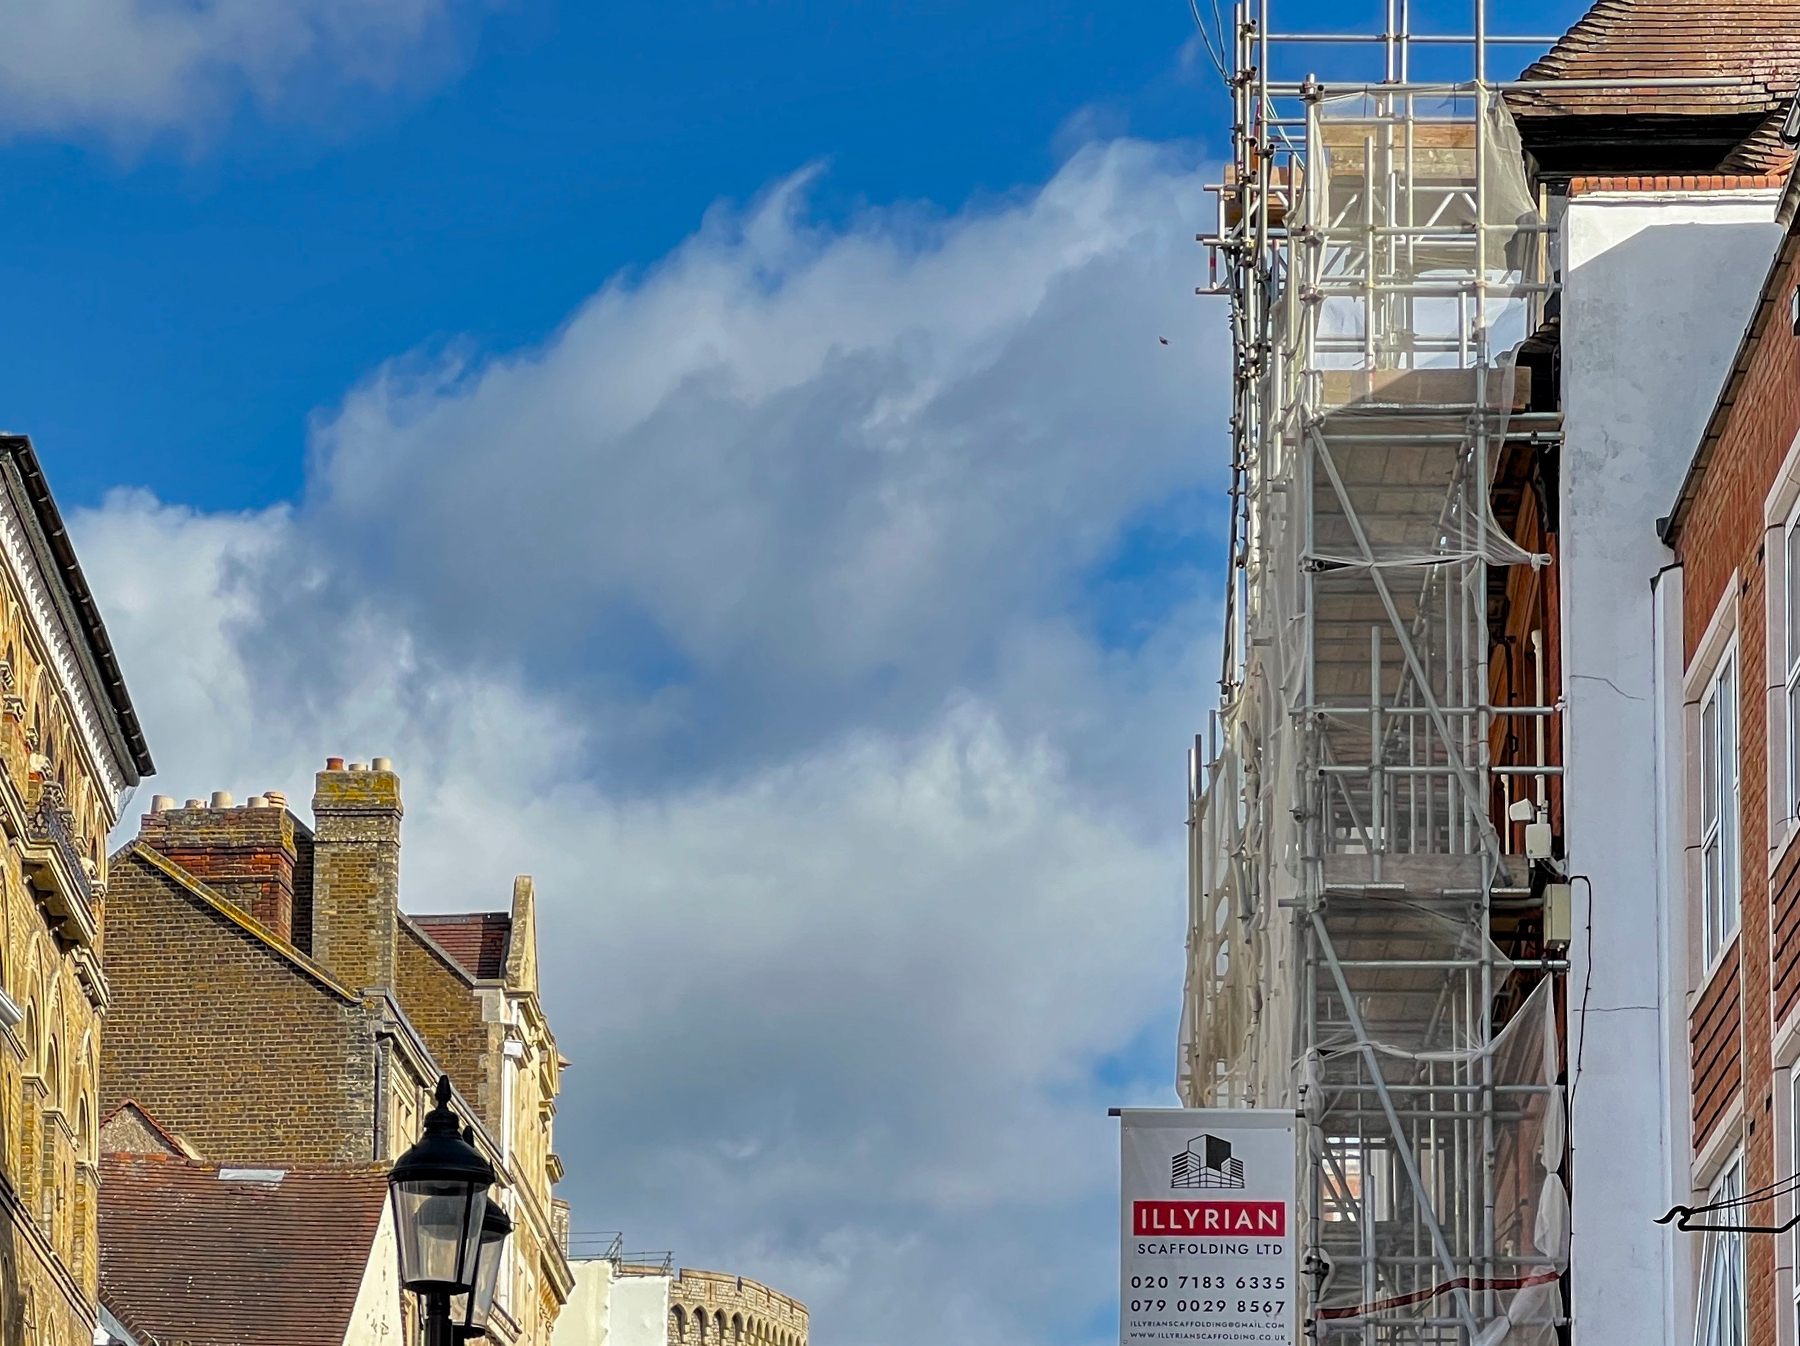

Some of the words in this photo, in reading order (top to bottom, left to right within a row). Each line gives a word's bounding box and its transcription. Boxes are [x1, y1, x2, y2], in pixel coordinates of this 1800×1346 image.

[1141, 1208, 1278, 1230] ILLYRIAN
[1137, 1243, 1249, 1255] SCAFFOLDING
[1256, 1243, 1283, 1255] LTD
[1131, 1276, 1168, 1289] 020
[1178, 1276, 1225, 1289] 7183
[1235, 1276, 1285, 1290] 6335
[1131, 1300, 1166, 1312] 079
[1177, 1300, 1226, 1313] 0029
[1237, 1301, 1285, 1314] 8567
[1130, 1332, 1286, 1341] WWW.ILLYRIANSCAFFOLDING.CO.UK
